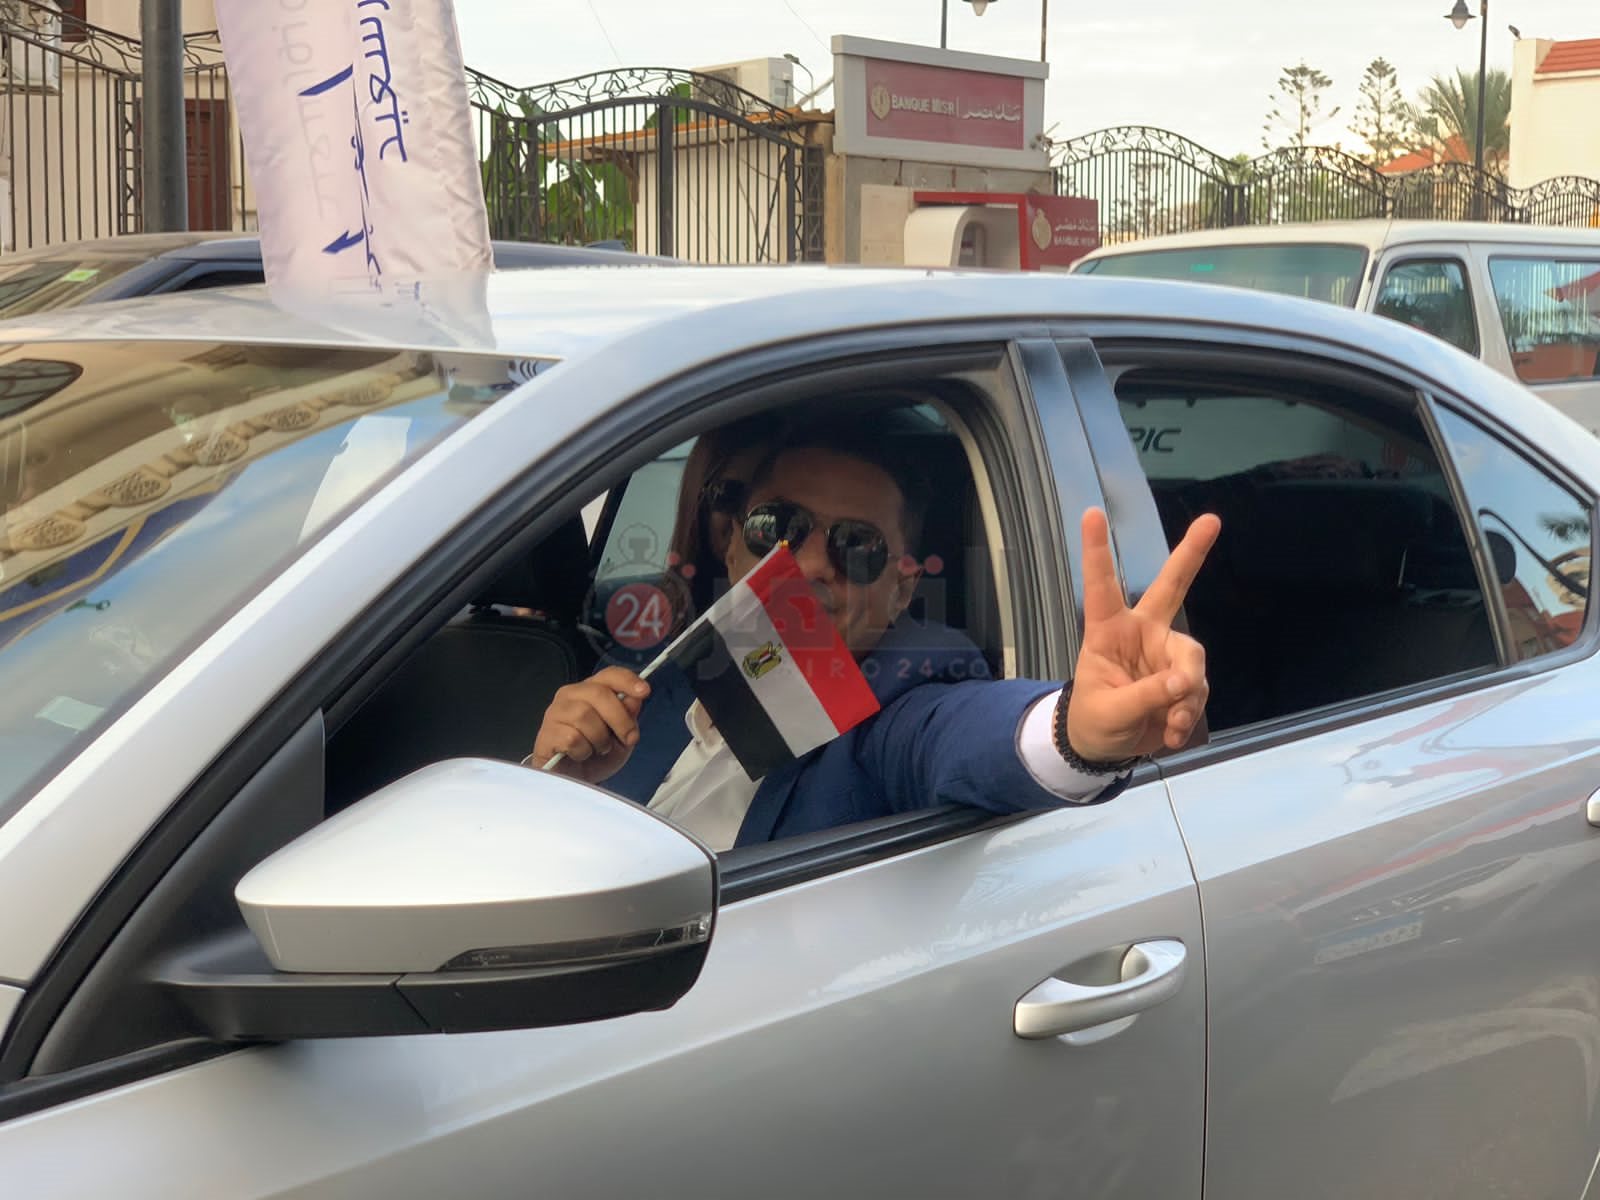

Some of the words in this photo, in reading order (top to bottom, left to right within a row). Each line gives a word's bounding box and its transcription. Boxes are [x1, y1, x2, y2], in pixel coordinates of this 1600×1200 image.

[891, 93, 931, 113] BANQUE
[931, 96, 955, 116] MISR
[962, 107, 994, 121] مصر
